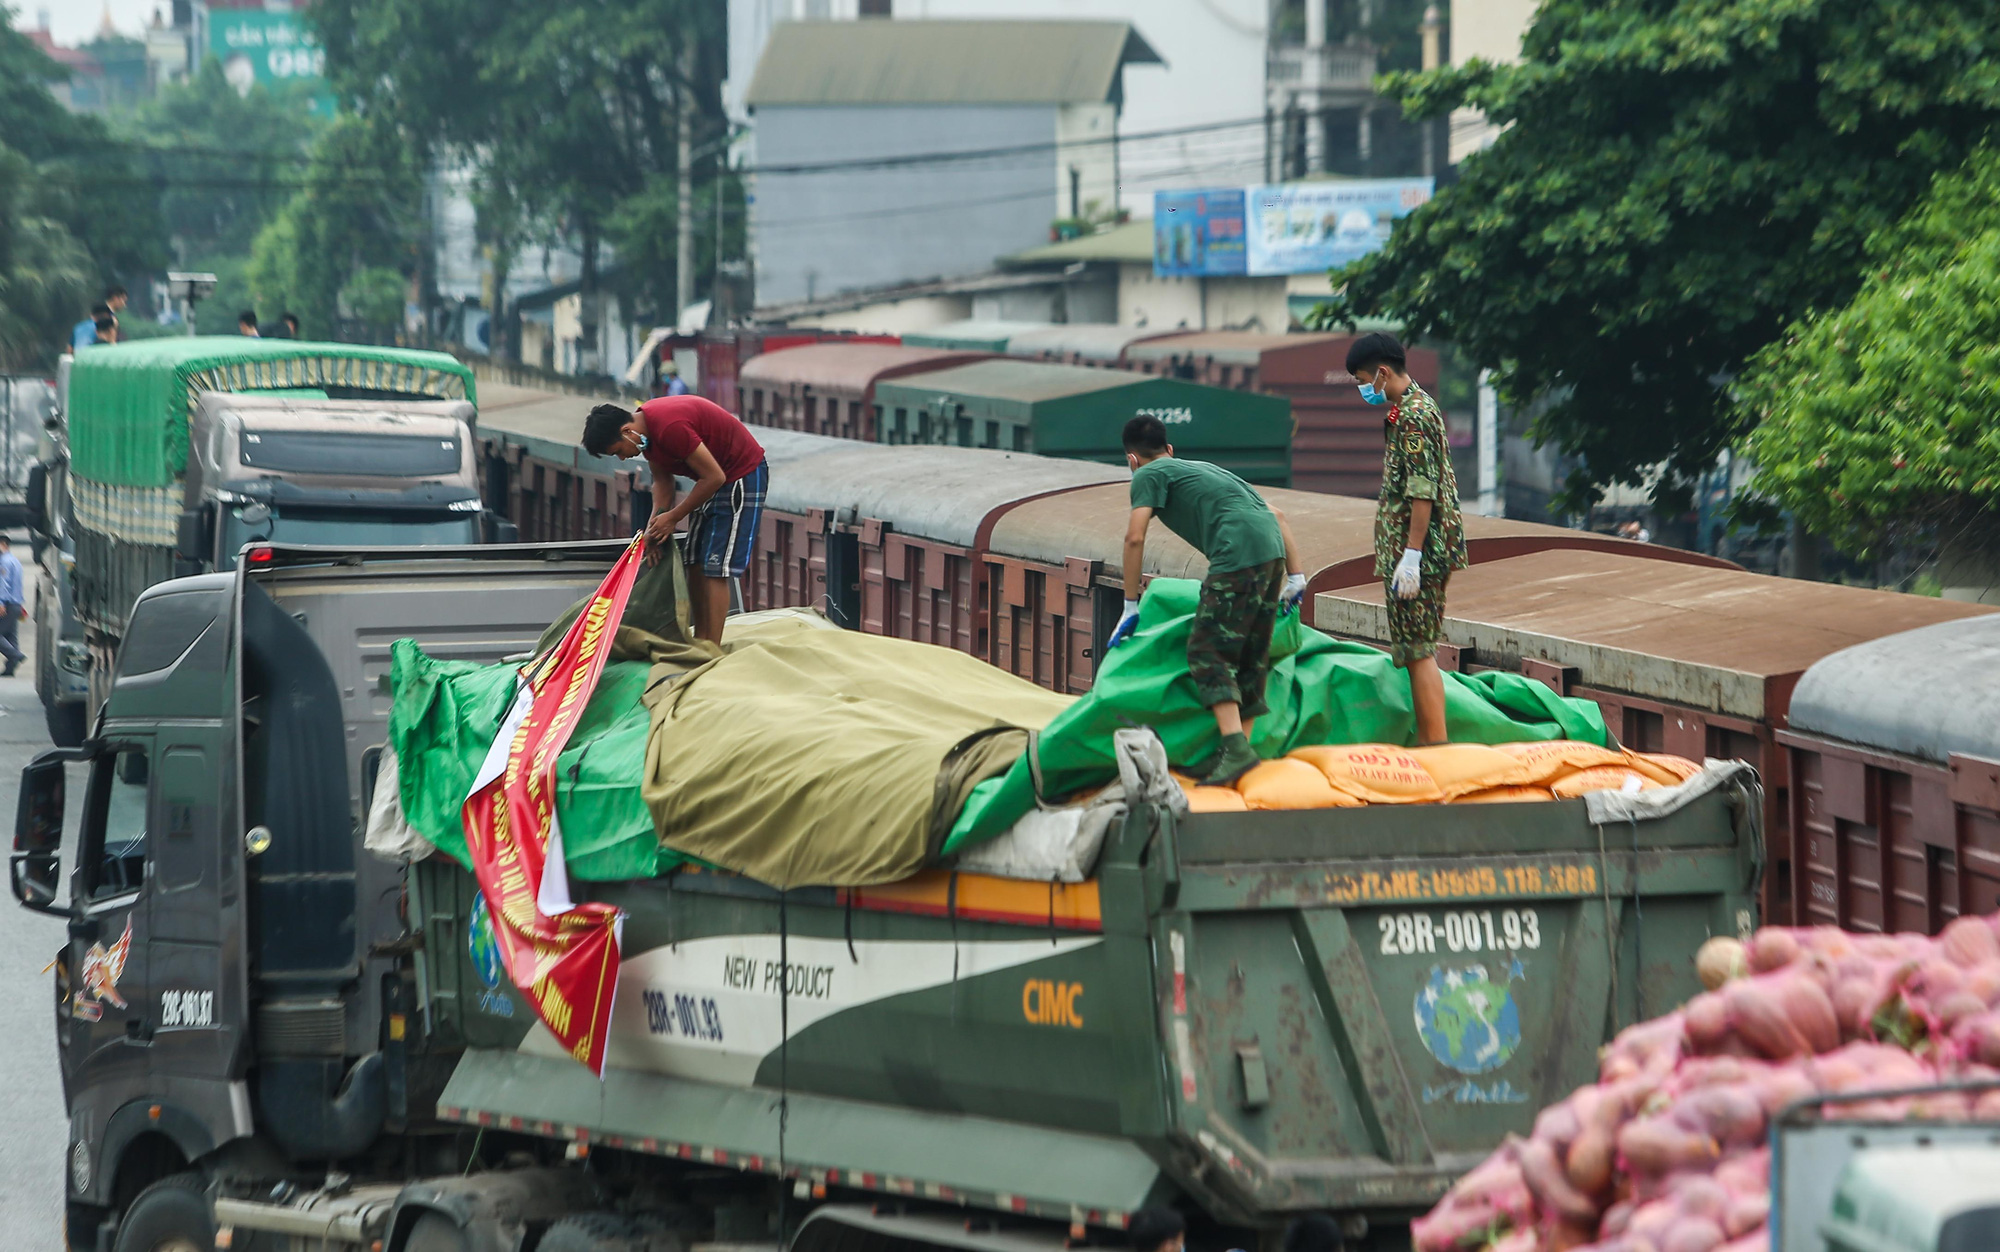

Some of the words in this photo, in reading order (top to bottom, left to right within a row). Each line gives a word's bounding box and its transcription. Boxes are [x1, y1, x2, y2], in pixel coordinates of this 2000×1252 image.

[1378, 908, 1541, 955] 28R-001.93
[723, 955, 758, 990] NEW
[763, 961, 835, 1000] PRODUCT
[643, 988, 724, 1043] 28R-001.93
[1022, 978, 1084, 1029] CIMC
